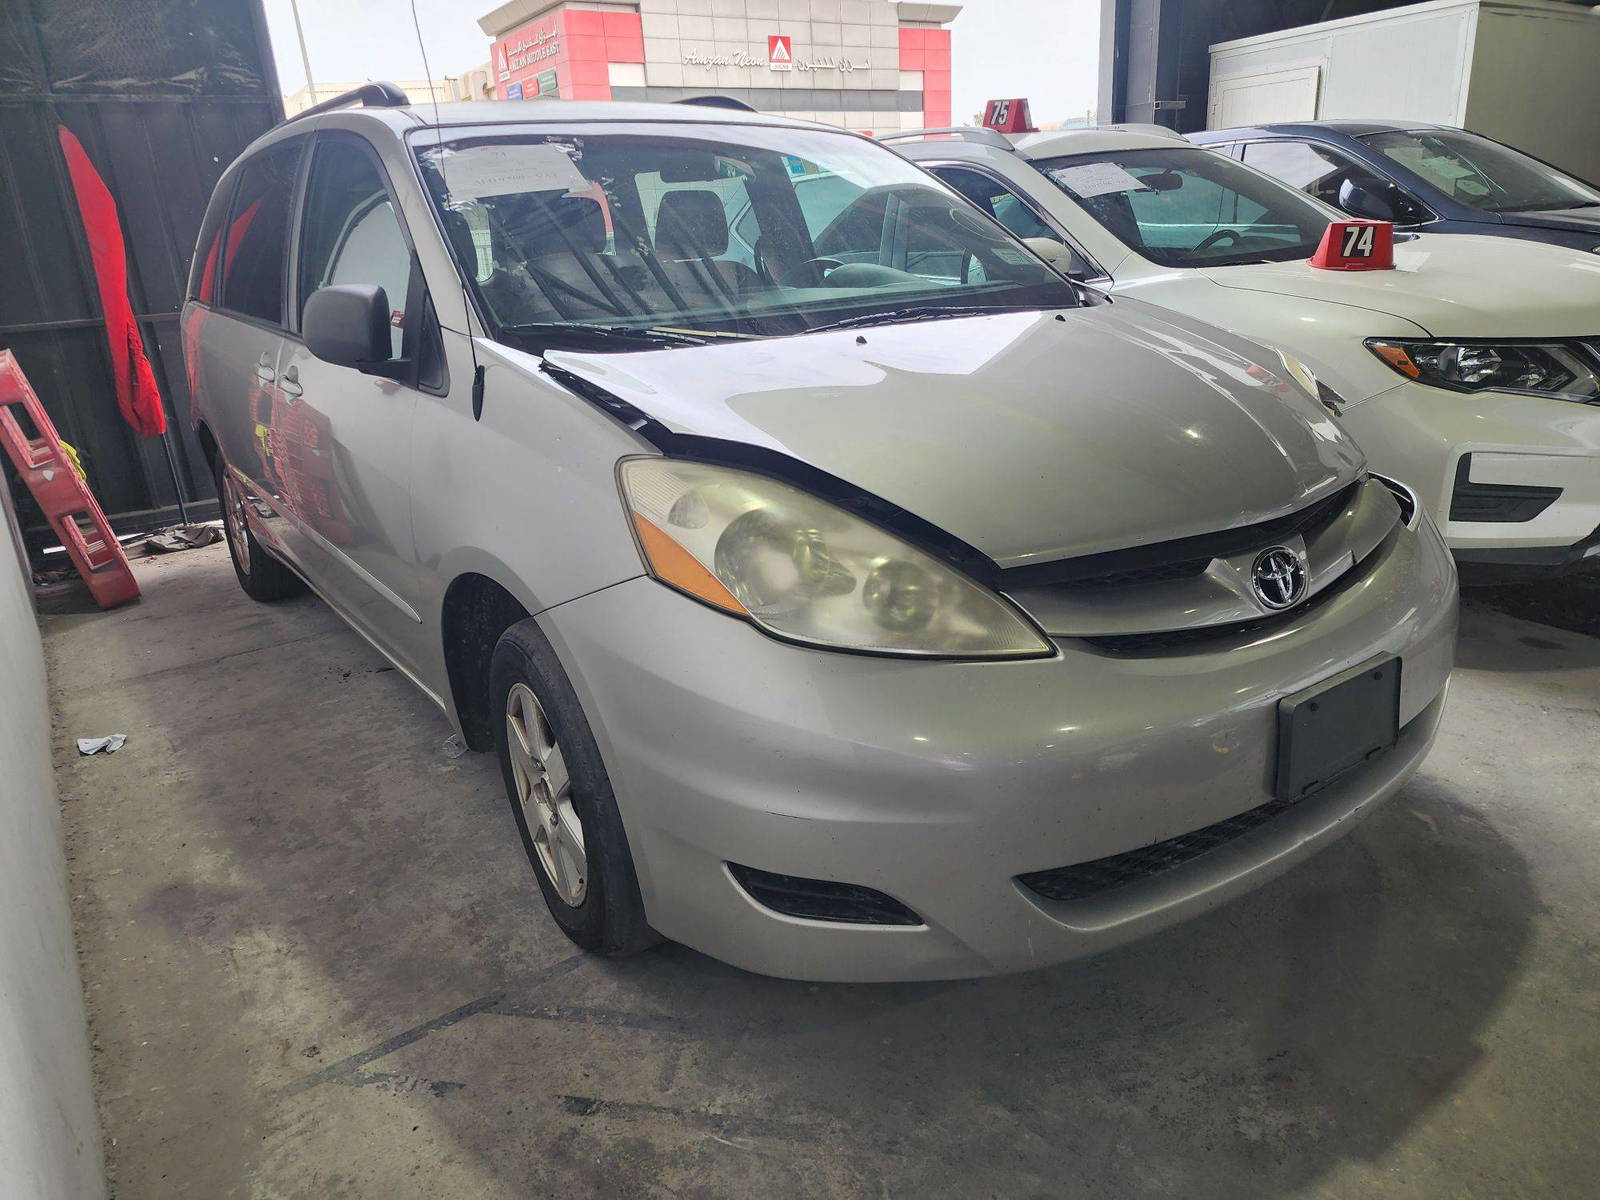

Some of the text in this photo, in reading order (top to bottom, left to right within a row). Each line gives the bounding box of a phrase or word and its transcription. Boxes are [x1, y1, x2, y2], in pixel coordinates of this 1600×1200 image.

[547, 42, 561, 57] EAST
[733, 49, 766, 67] Neon
[990, 101, 1010, 125] 75
[1343, 226, 1374, 257] 74
